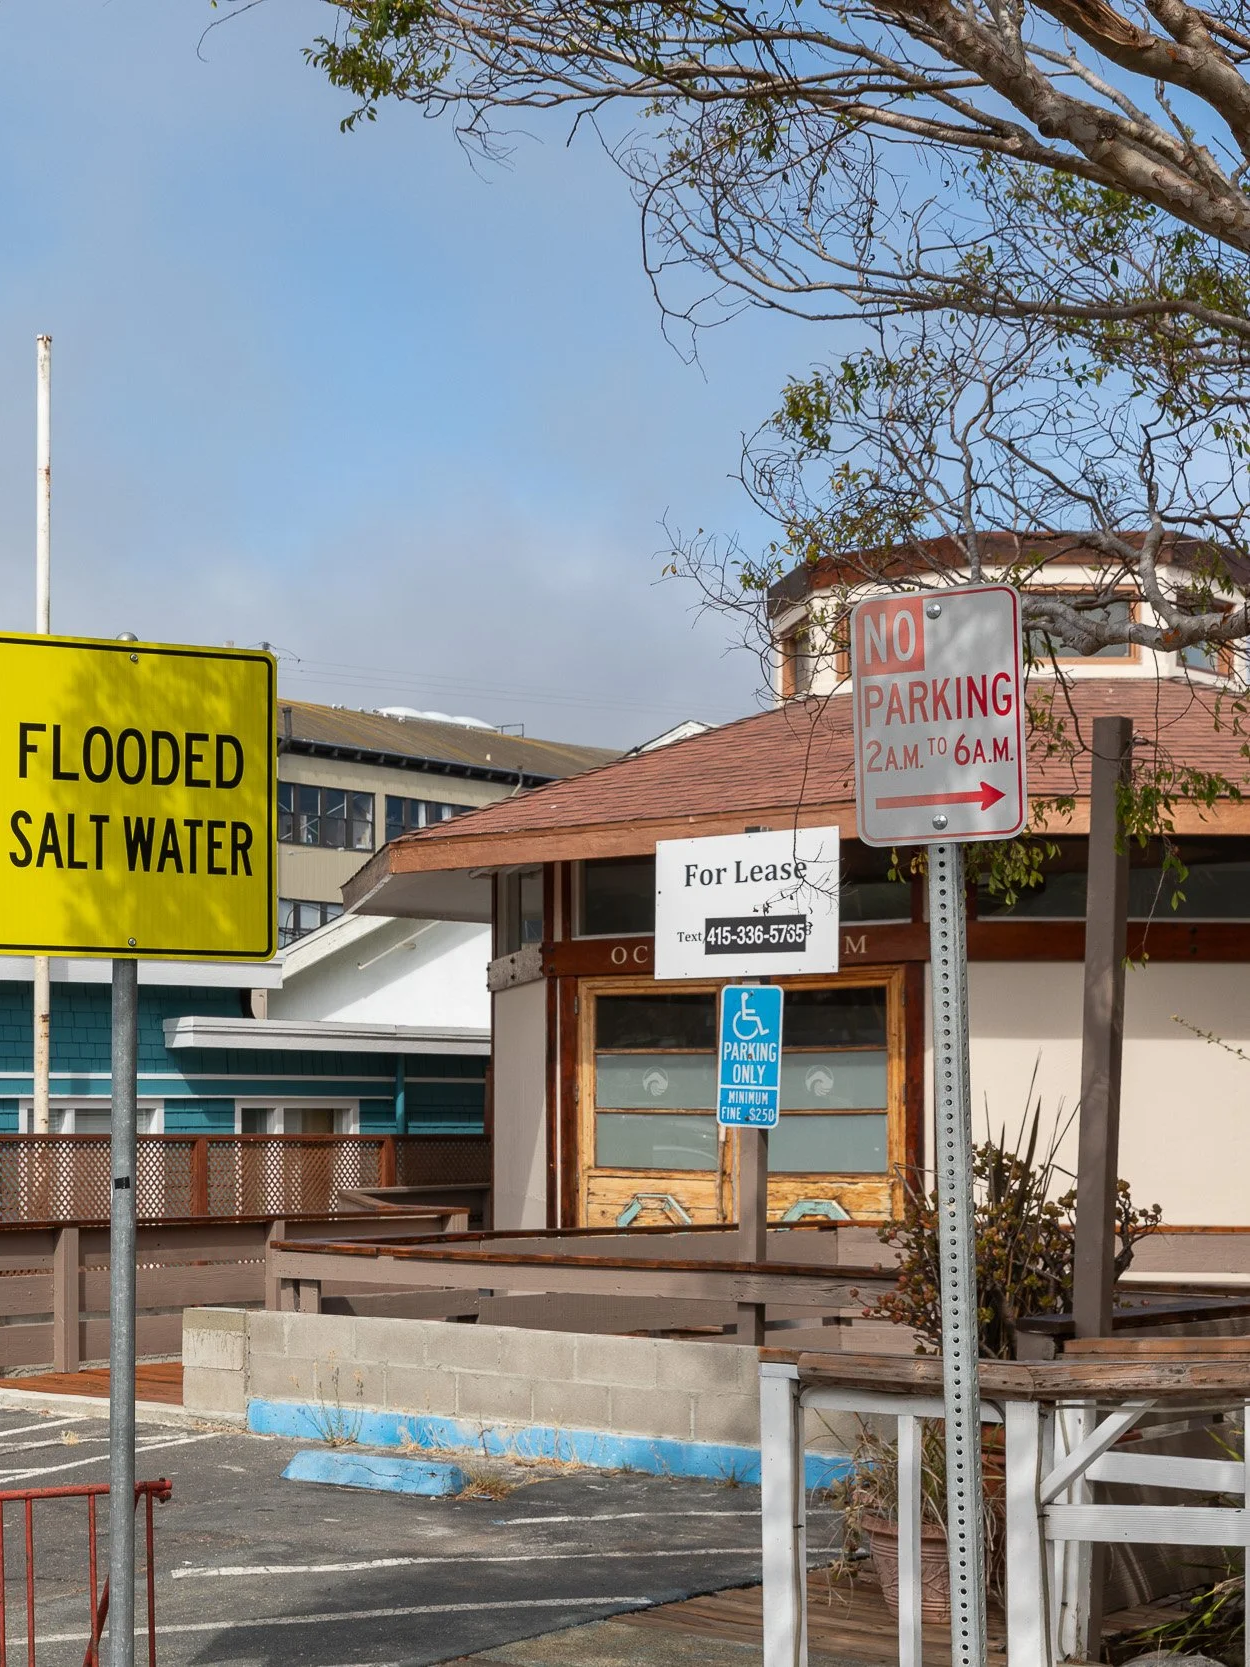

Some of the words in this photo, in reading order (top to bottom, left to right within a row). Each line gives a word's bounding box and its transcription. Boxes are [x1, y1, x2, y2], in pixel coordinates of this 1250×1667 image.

[864, 609, 916, 664] NO
[864, 672, 1012, 728] PARKING
[19, 722, 244, 789] FLOODED
[927, 736, 947, 756] TO
[9, 810, 110, 870] SALT
[123, 816, 253, 876] WATER
[684, 864, 727, 887] For
[734, 860, 807, 883] Lease
[723, 1042, 777, 1062] PARKING
[732, 1064, 766, 1084] ONLY
[728, 1090, 768, 1105] MINIMUM
[721, 1106, 742, 1120] FINE
[748, 1107, 774, 1122] $250
